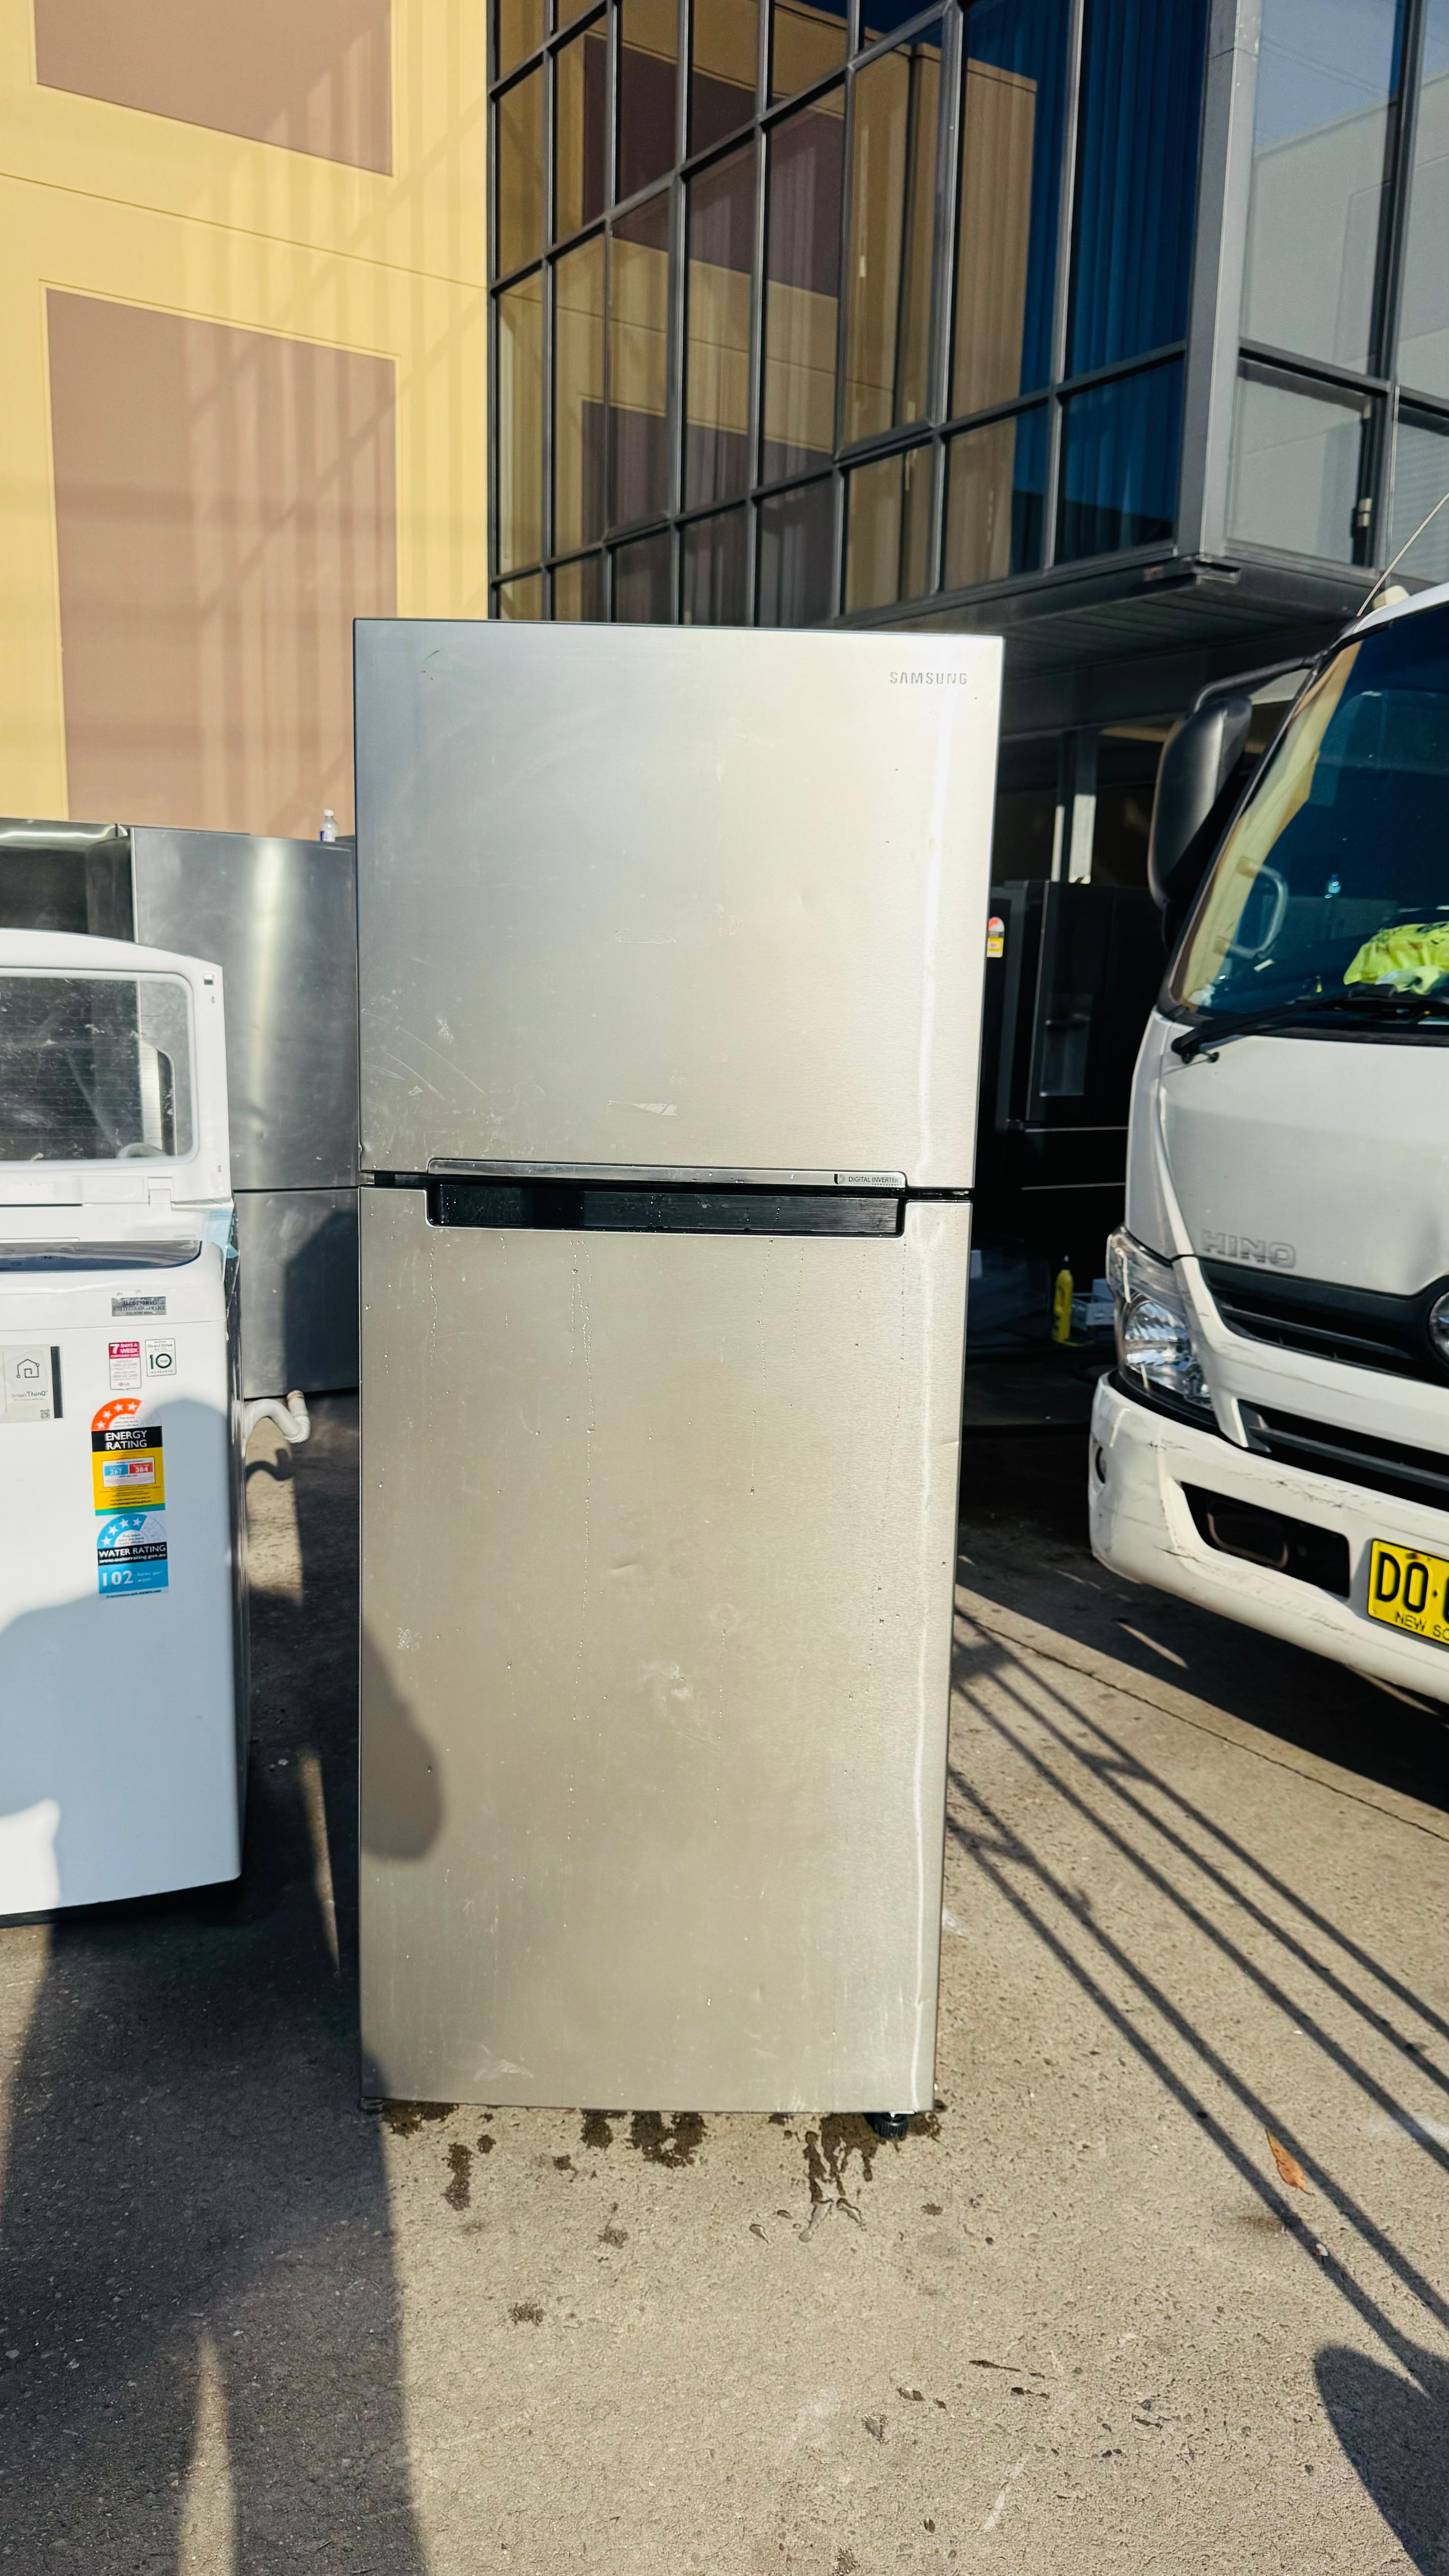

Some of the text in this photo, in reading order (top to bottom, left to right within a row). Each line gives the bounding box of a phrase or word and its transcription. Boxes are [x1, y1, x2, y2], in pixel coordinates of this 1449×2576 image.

[890, 672, 967, 684] SAMSUNG
[1200, 1229, 1297, 1268] HINO
[109, 1344, 120, 1354] 7
[149, 1353, 173, 1370] 10
[105, 1430, 147, 1441] ENERGY
[105, 1439, 147, 1451] RATING
[99, 1545, 166, 1558] WATER RATING
[102, 1570, 133, 1587] 102
[1376, 1551, 1449, 1624] DO
[1395, 1612, 1427, 1632] NEW
